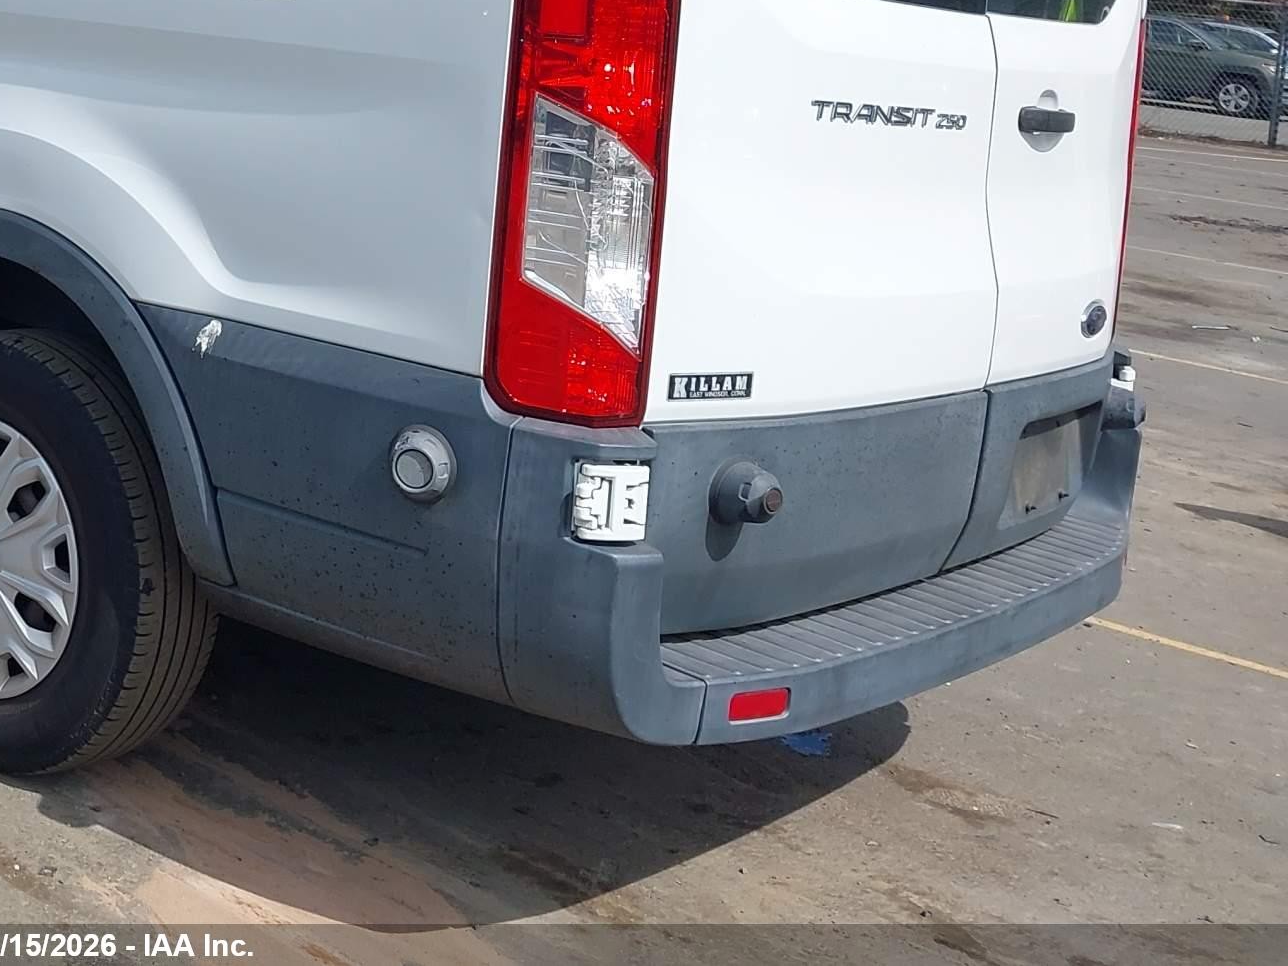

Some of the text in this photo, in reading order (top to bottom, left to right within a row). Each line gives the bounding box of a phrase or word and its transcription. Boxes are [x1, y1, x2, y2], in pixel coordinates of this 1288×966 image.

[811, 99, 968, 131] TRANSIT 250
[672, 375, 748, 398] KILLAM
